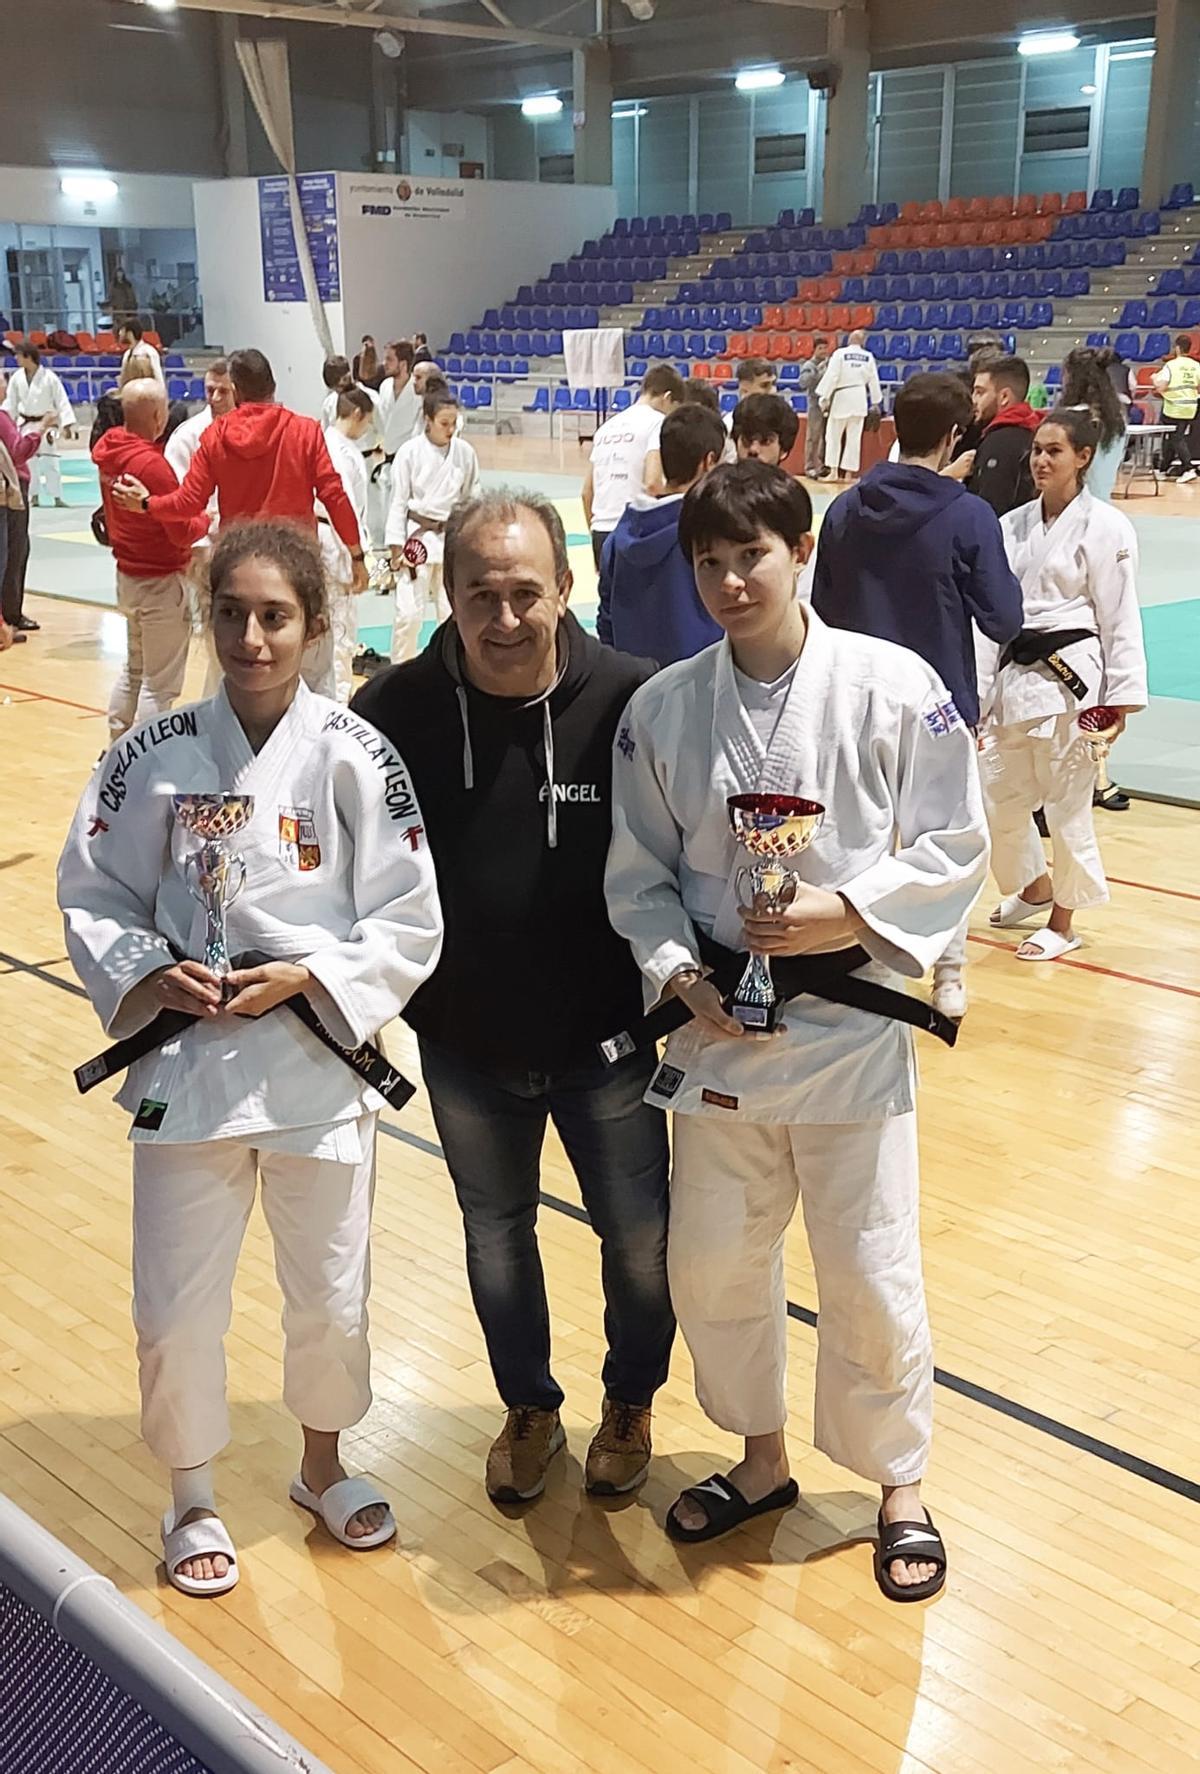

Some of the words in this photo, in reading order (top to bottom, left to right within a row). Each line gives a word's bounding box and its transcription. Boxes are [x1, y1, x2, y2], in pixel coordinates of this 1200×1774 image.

[149, 711, 198, 746] LEON
[321, 711, 387, 762] CASTILLA
[384, 770, 418, 820] LEON
[538, 780, 601, 802] ÁNGEL
